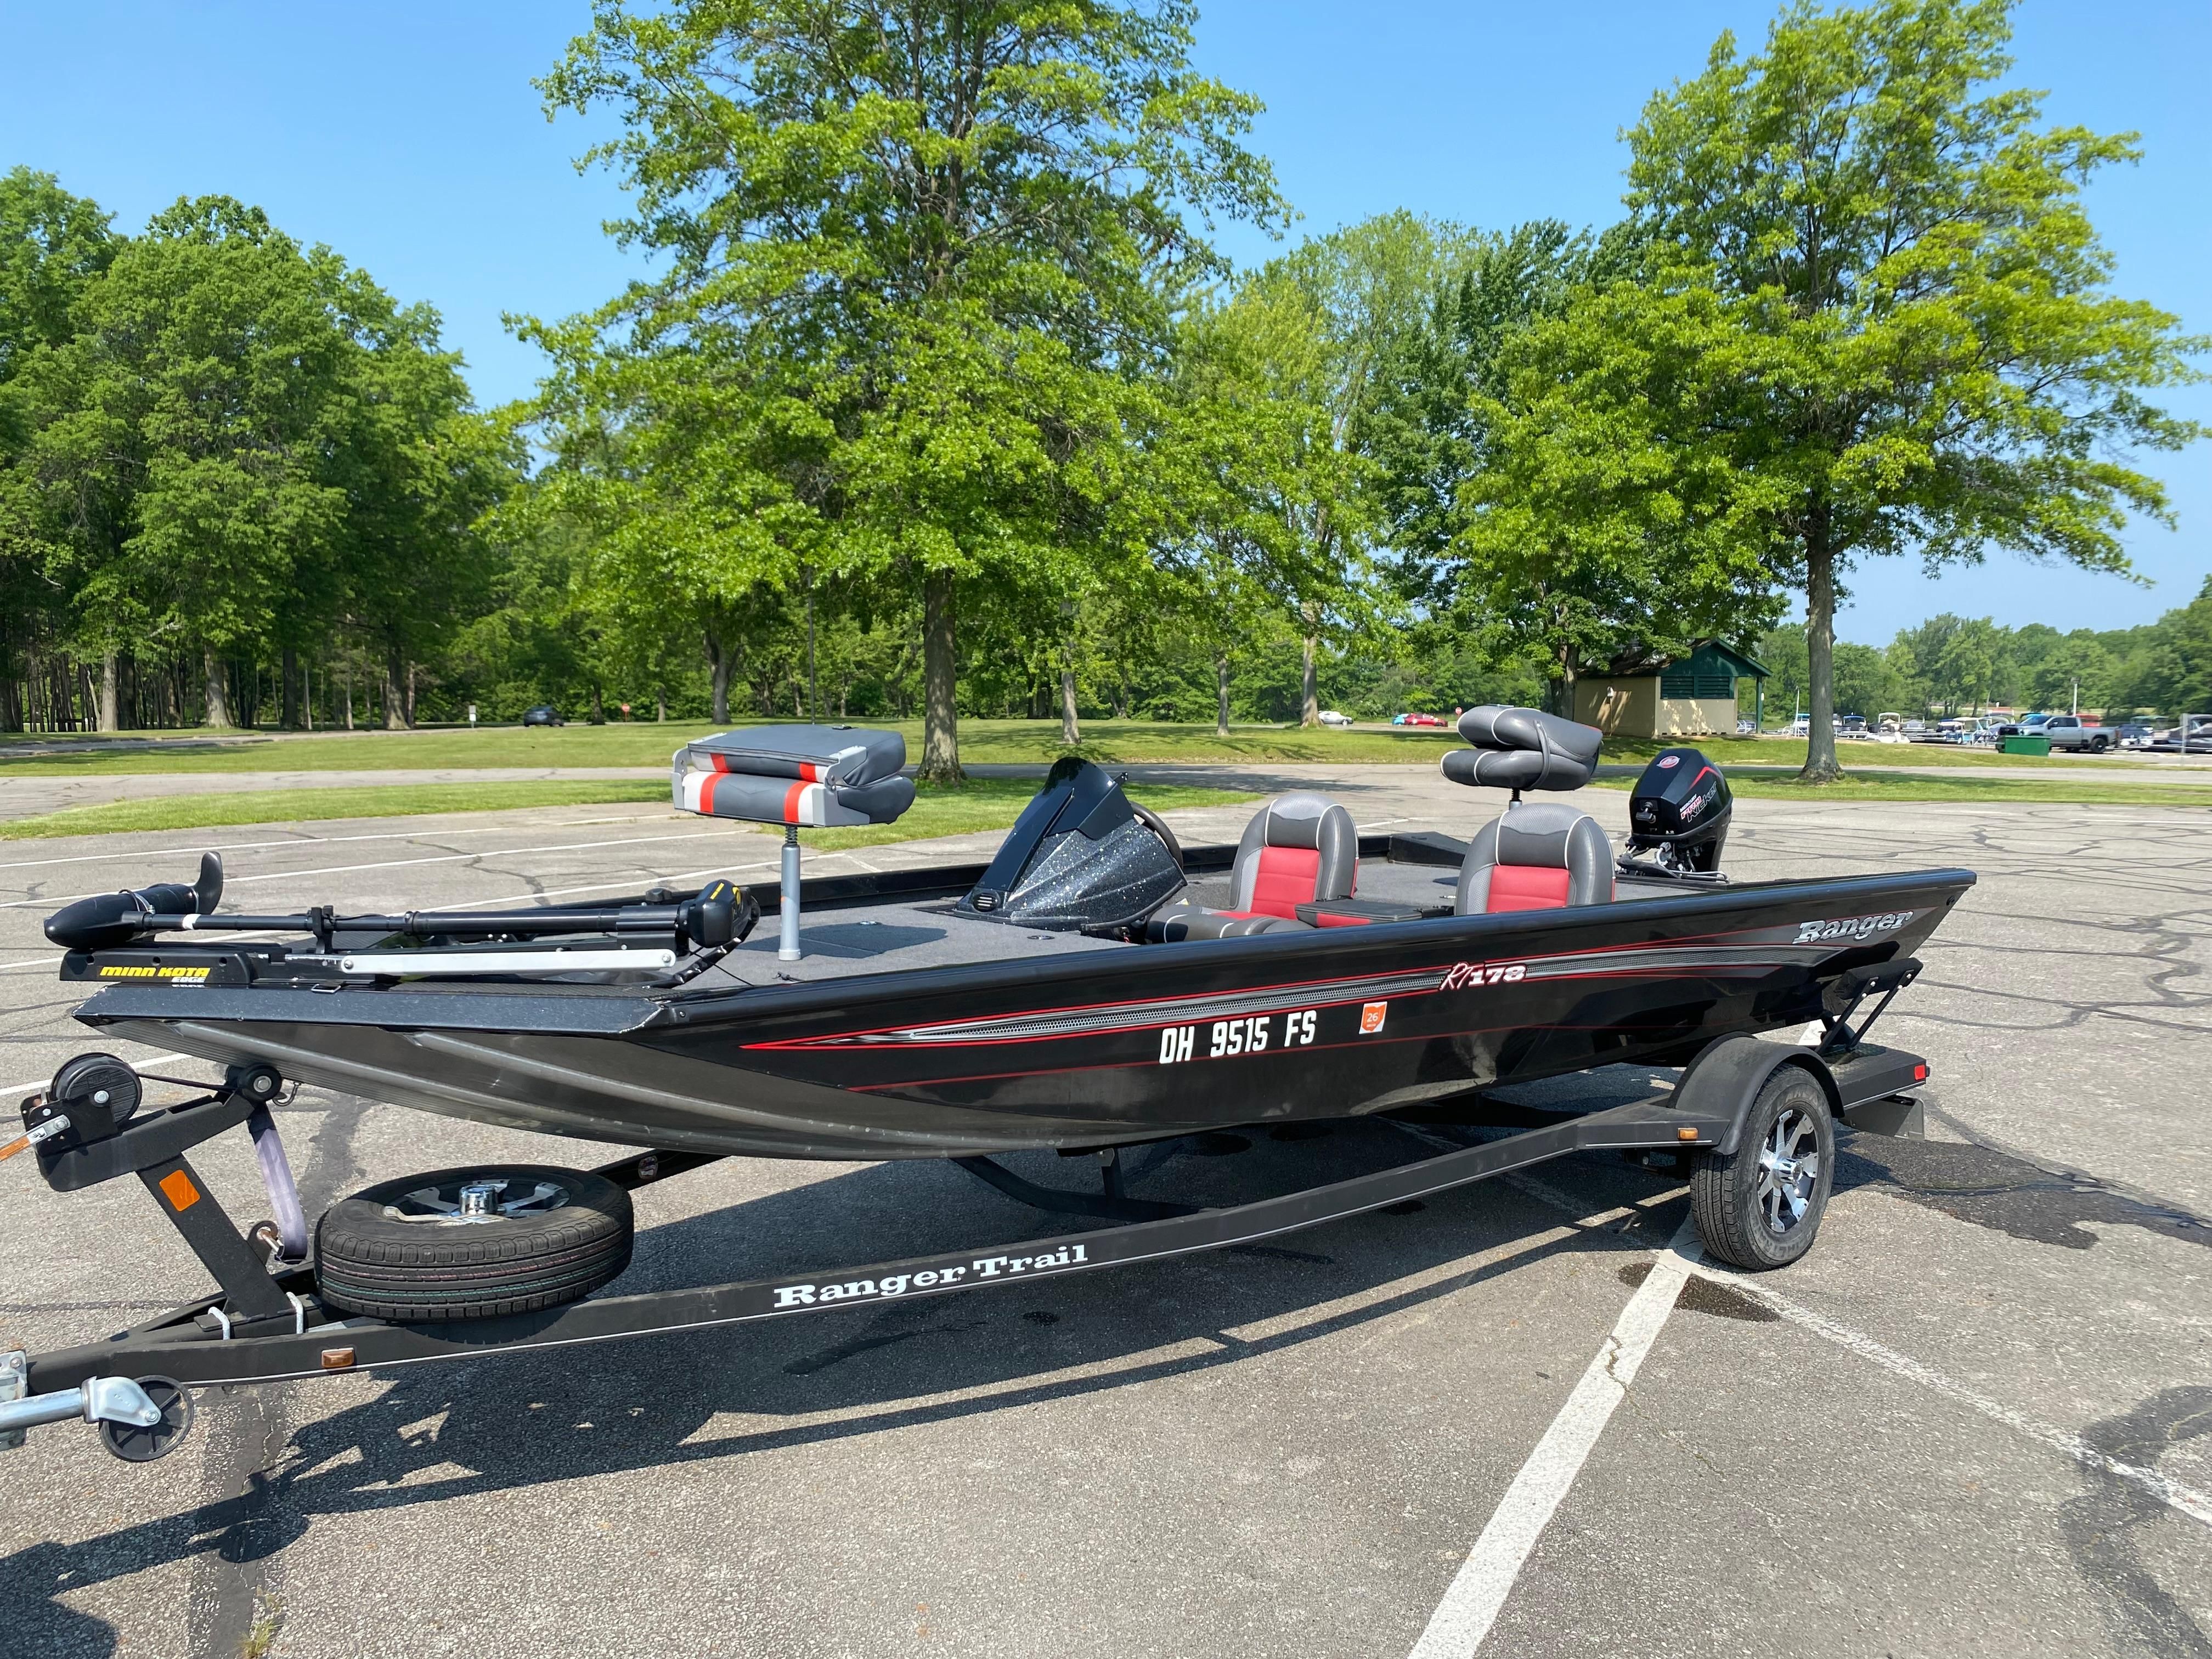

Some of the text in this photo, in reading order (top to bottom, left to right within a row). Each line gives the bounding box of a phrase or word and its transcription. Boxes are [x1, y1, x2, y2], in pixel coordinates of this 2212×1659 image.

[1792, 911, 1914, 944] Ranger
[100, 966, 211, 977] MINN KOTA
[1367, 1012, 1379, 1023] 26
[1159, 1010, 1317, 1064] OH 9515 FS
[774, 1244, 1088, 1308] Ranger Trail
